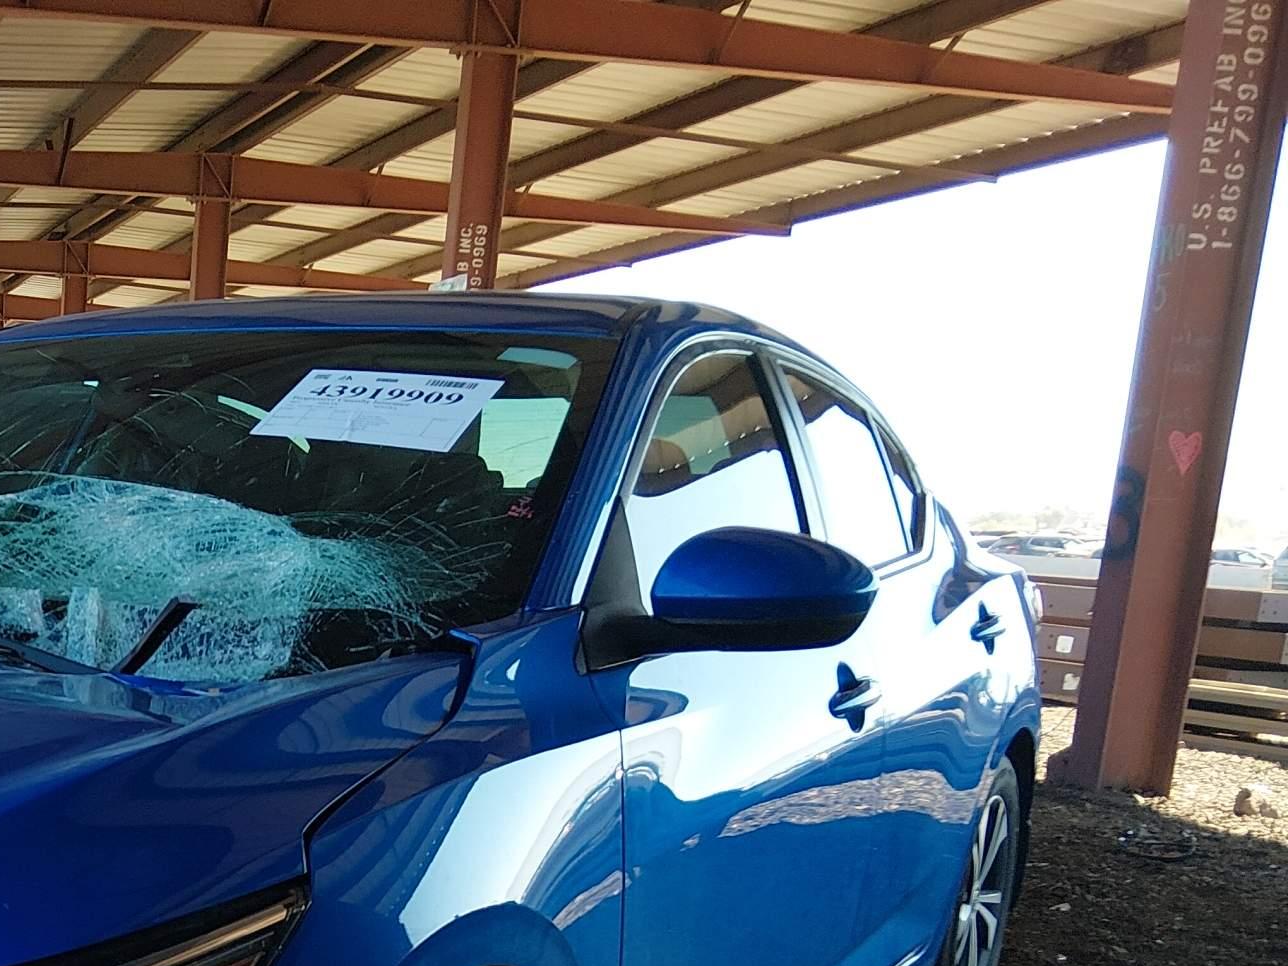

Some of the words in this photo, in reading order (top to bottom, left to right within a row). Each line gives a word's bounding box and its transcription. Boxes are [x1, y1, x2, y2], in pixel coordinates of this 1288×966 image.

[1223, 0, 1247, 35] IN
[1199, 53, 1237, 174] PREFAB
[459, 223, 474, 254] INC.
[1187, 194, 1215, 250] U.S.
[469, 224, 488, 291] 9-0969
[309, 384, 464, 406] 43919909
